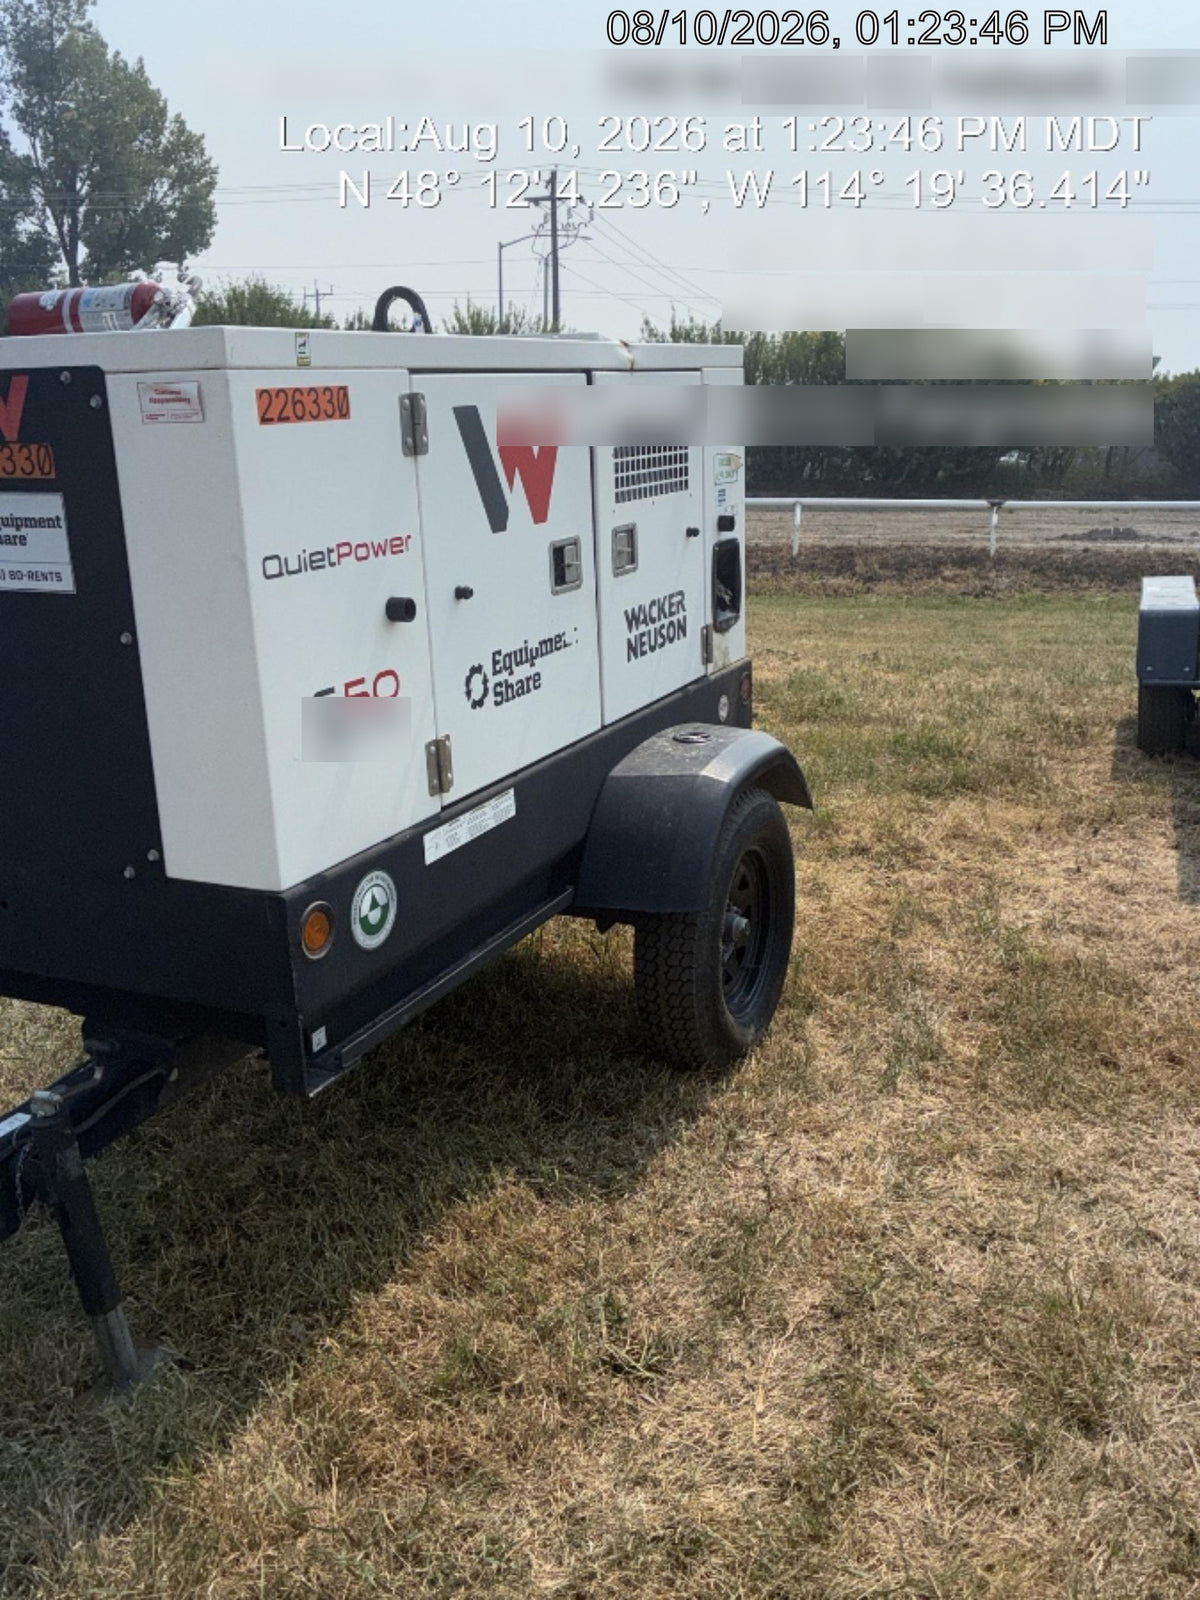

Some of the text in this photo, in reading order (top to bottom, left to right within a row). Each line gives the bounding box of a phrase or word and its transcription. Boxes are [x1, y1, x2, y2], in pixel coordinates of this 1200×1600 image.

[258, 386, 350, 423] 226330
[0, 513, 63, 532] uipment
[261, 534, 412, 580] QuietPower
[8, 569, 63, 583] 80-RENTS
[624, 590, 687, 634] WACKER
[491, 626, 579, 677] Equipme
[626, 614, 688, 664] NEUSON
[313, 668, 400, 698] 50
[493, 671, 542, 707] Share
